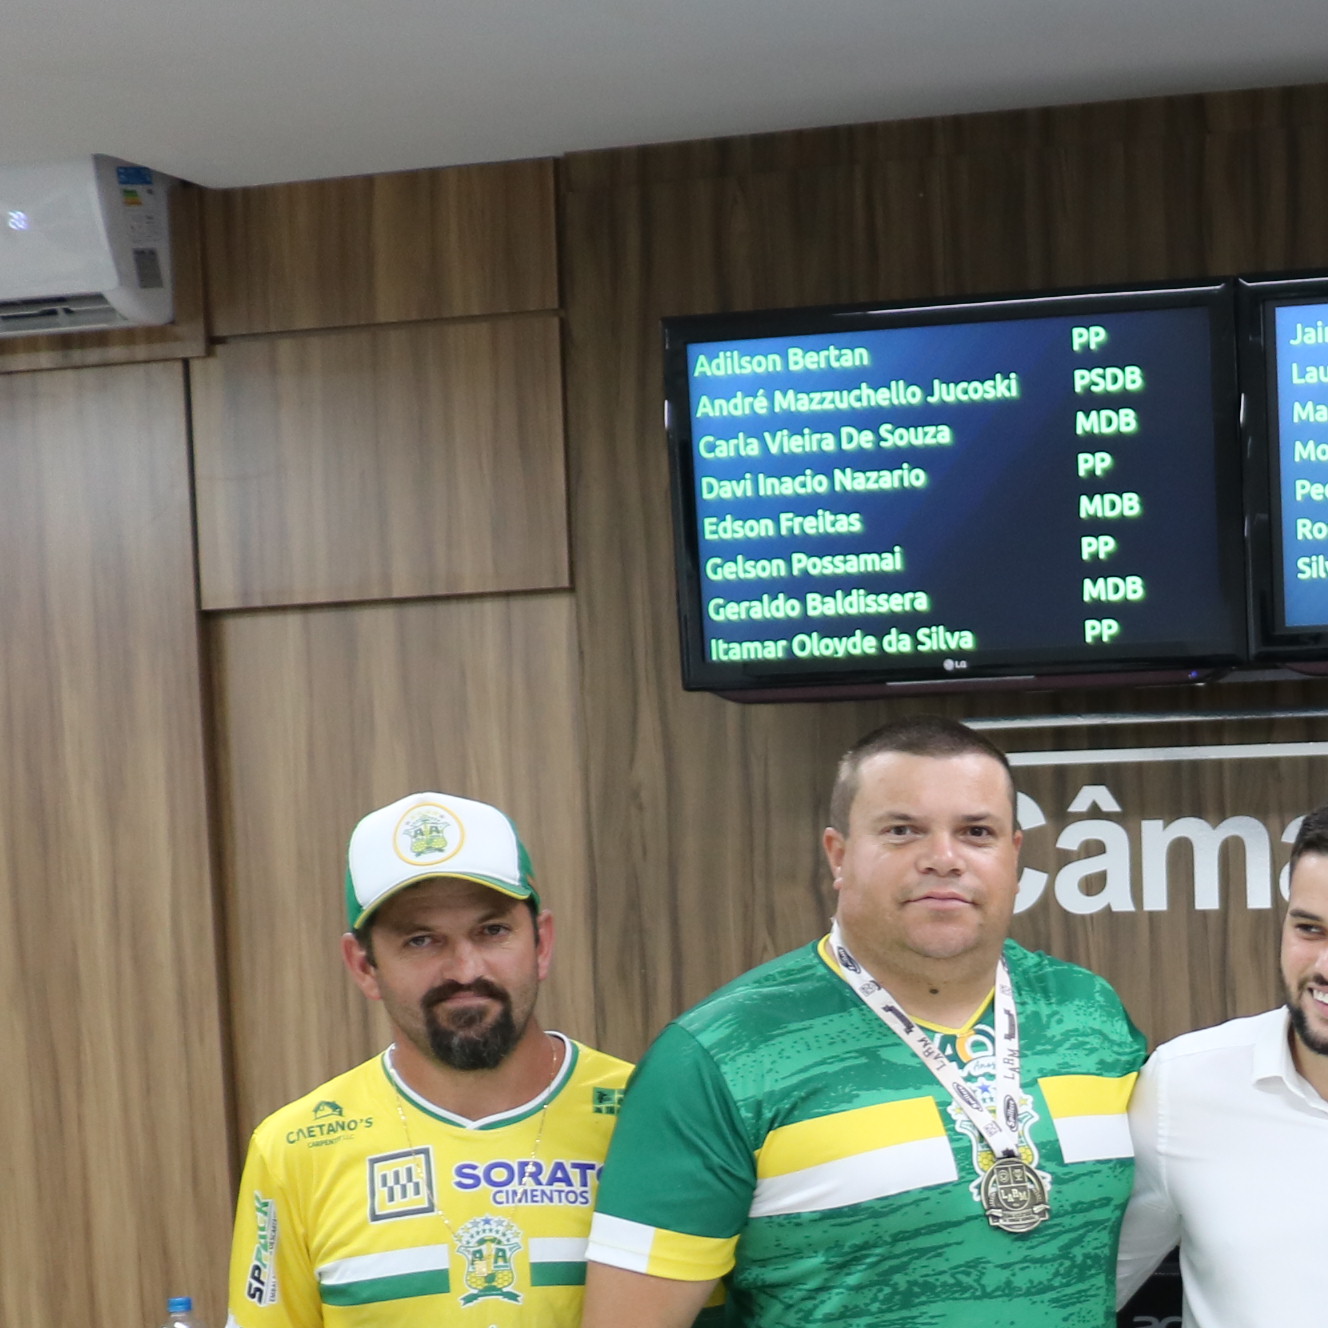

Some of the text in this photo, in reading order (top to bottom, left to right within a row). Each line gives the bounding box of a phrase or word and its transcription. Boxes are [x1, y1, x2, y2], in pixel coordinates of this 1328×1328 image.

[1072, 327, 1106, 351] PP
[694, 345, 868, 377] Adilson Bertan
[1074, 367, 1143, 392] PSDB
[696, 373, 1017, 418] André Mazzuchello Jucoski
[1075, 409, 1137, 435] MDB
[699, 423, 950, 459] Carla Vieira De Souza
[1077, 453, 1112, 477] PP
[701, 464, 926, 499] Davi Inacio Nazario
[1079, 494, 1141, 518] MDB
[704, 510, 861, 540] Edson Freitas
[1081, 536, 1116, 560] PP
[705, 545, 902, 581] Gelson Possamai
[1083, 577, 1145, 602] MDB
[708, 589, 928, 622] Geraldo Baldissera
[711, 627, 974, 662] Itamar Oloyde da Silva
[1084, 620, 1119, 643] PP
[955, 660, 966, 668] LG
[918, 1037, 946, 1071] LARM
[1003, 1049, 1021, 1079] LARM
[492, 1189, 590, 1205] CIMENTOS
